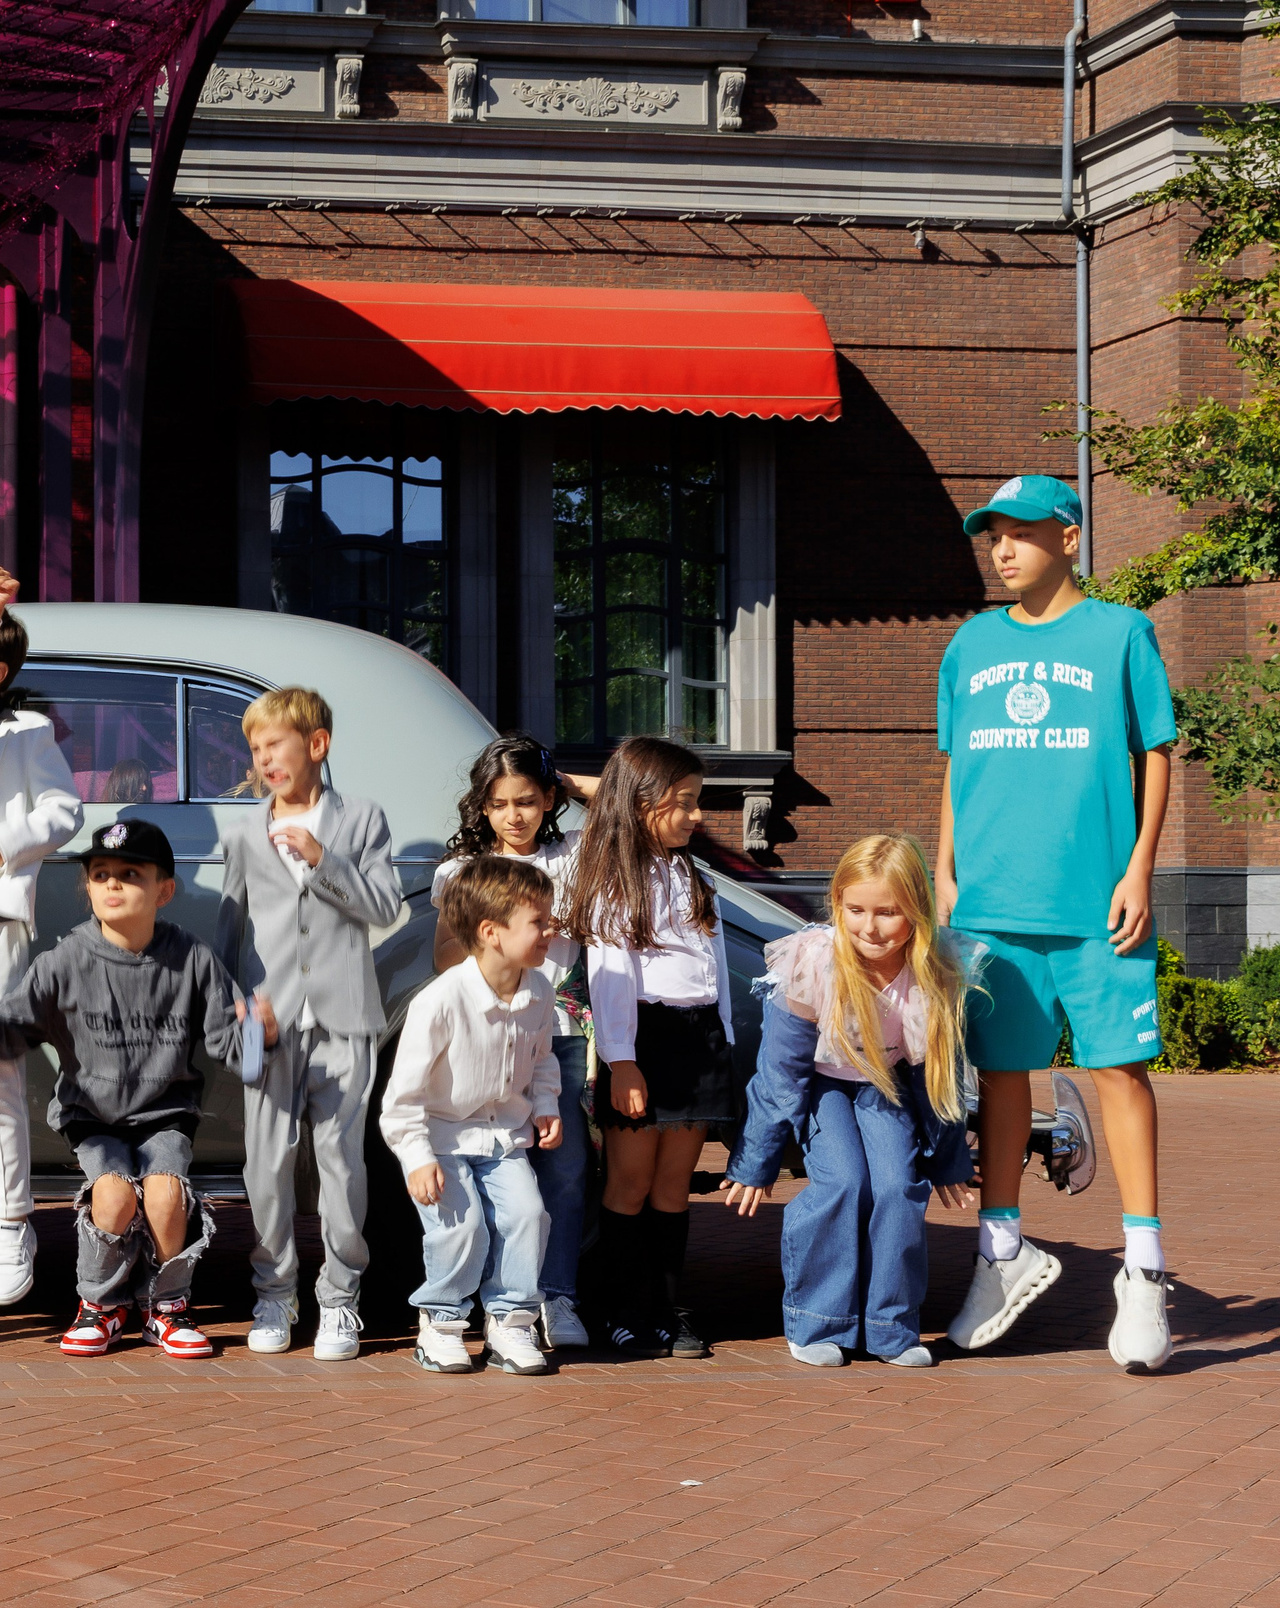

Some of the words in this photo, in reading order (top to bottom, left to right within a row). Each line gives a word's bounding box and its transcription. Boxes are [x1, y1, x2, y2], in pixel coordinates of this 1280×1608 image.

[970, 661, 1029, 695] SPORTY
[1033, 661, 1047, 682] &
[1052, 662, 1094, 693] RICH
[969, 728, 1040, 750] COUNTRY
[1044, 727, 1090, 749] CLUB
